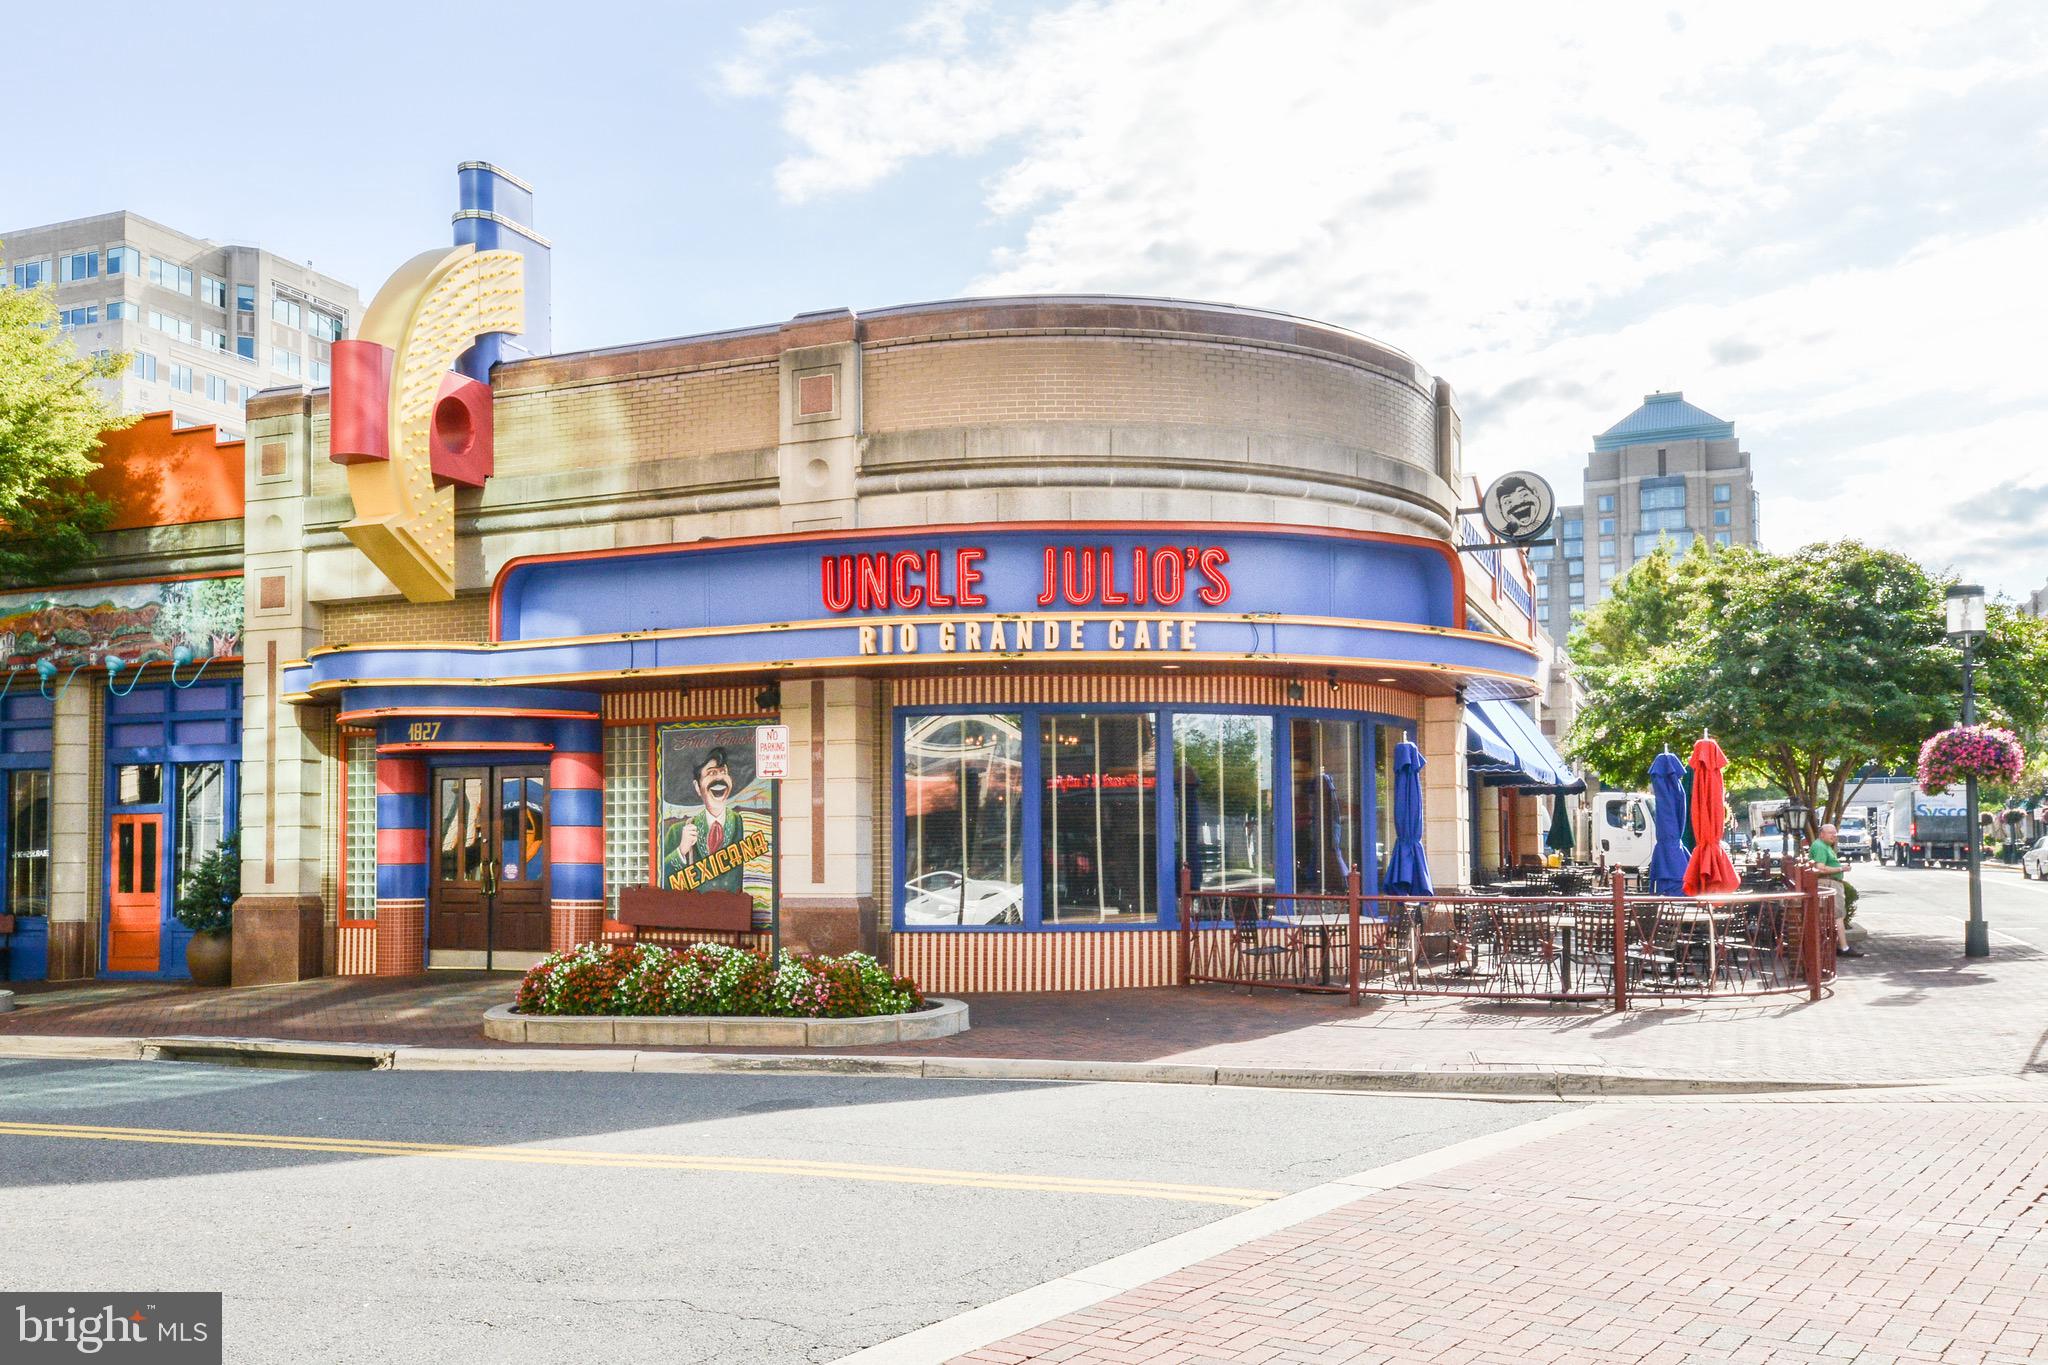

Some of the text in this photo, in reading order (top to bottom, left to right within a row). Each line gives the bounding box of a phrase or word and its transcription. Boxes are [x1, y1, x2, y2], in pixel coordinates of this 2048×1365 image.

[821, 545, 1231, 612] UNCLE JULIO'S
[859, 619, 1198, 655] RIO GRANDE CAFE
[407, 721, 442, 741] 1827
[766, 731, 779, 741] NO
[759, 742, 786, 752] PARKING
[765, 761, 780, 769] ZONE
[668, 830, 770, 891] MEXICANA
